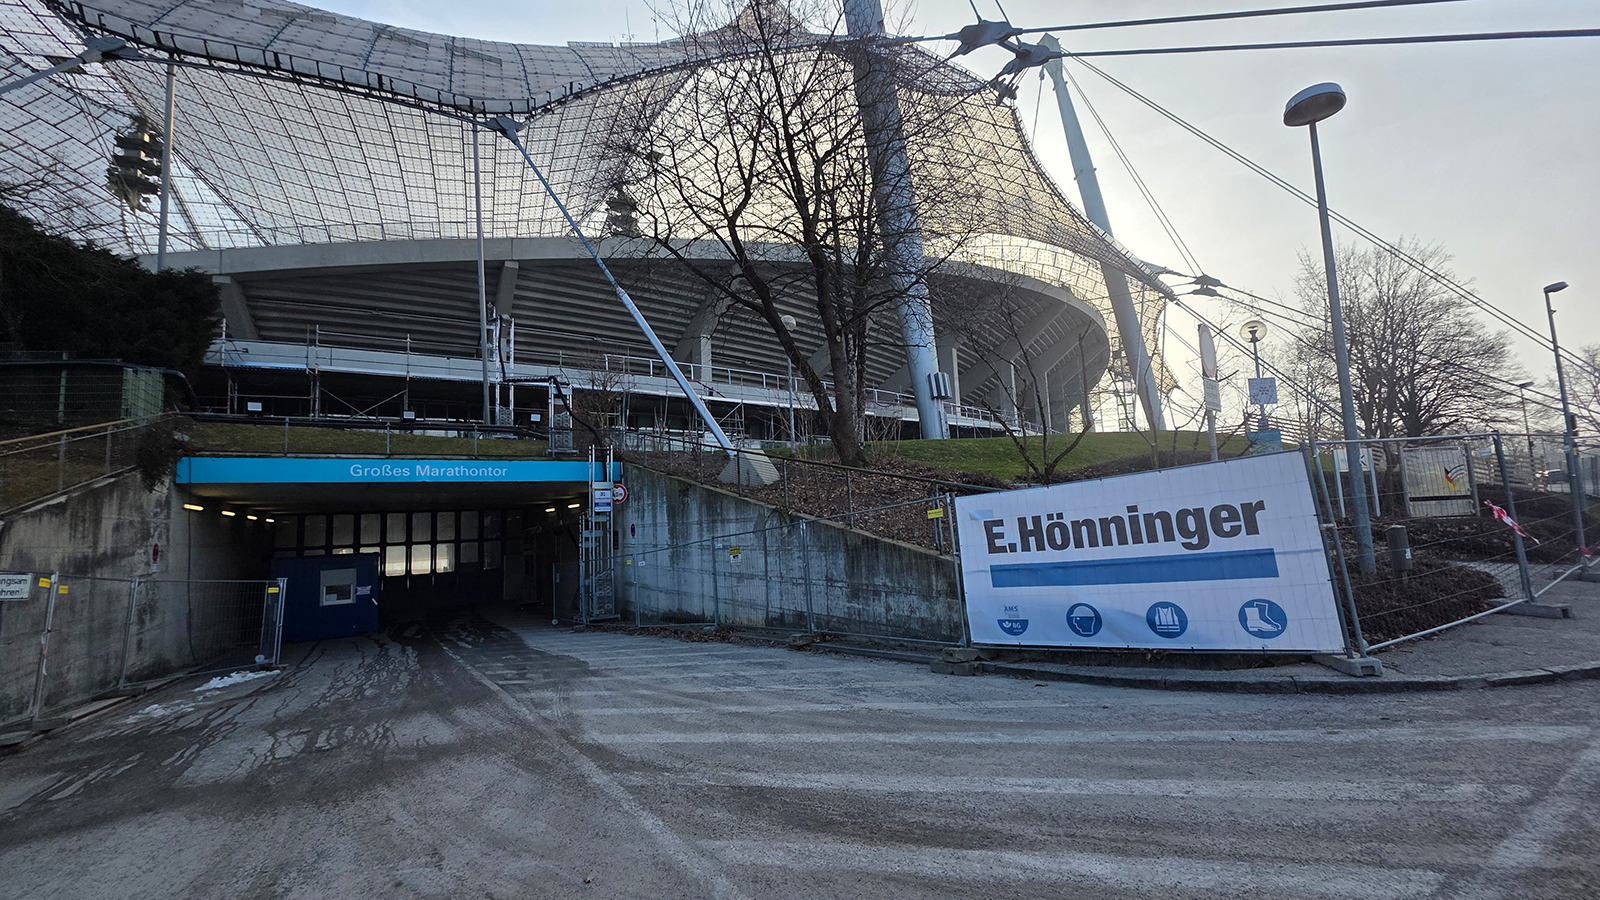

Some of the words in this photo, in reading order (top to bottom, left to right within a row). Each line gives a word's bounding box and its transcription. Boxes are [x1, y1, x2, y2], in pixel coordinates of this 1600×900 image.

[350, 464, 410, 477] Großes
[416, 464, 507, 477] Marathontor
[983, 500, 1266, 555] E.Hönninger
[0, 578, 27, 587] ngsam
